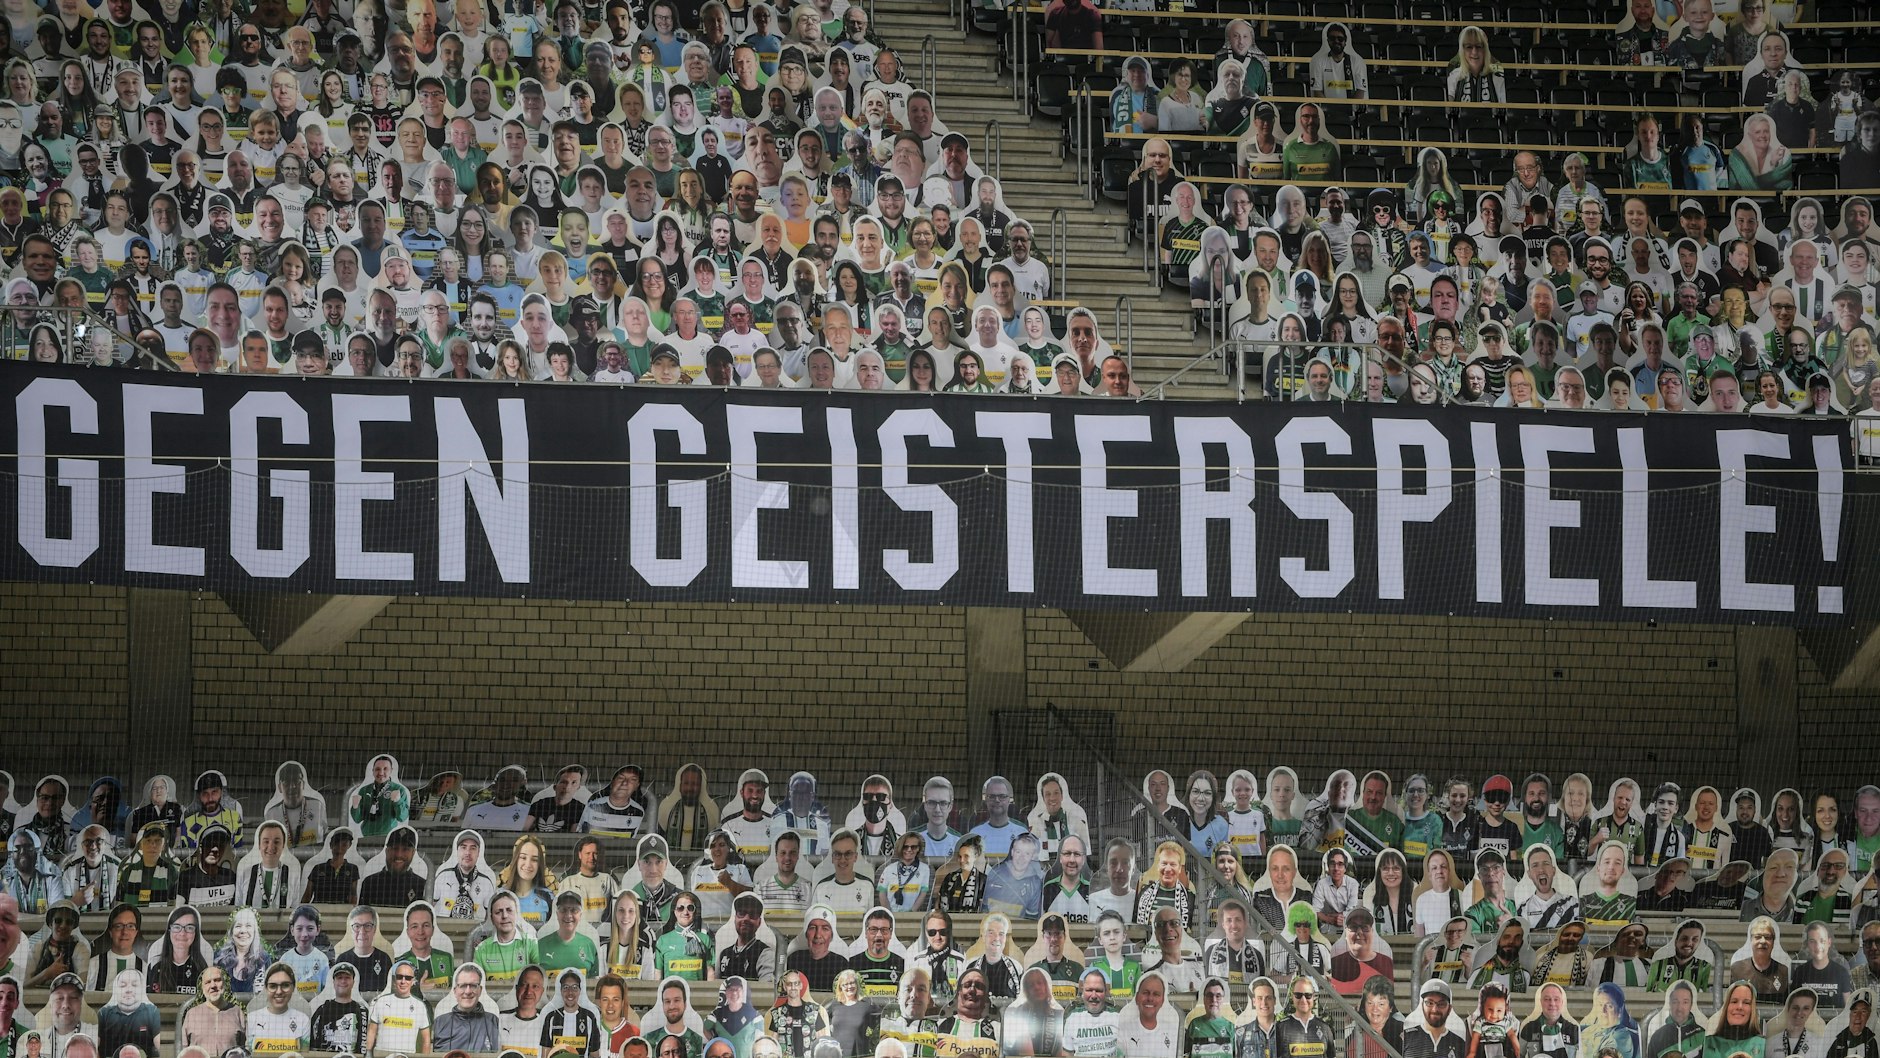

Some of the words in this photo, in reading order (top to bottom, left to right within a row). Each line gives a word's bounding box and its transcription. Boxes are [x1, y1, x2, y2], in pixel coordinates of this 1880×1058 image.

[15, 377, 530, 583] GEGEN
[627, 403, 1844, 613] GEISTERSPIELE!
[870, 986, 895, 995] Postbank
[1076, 1026, 1113, 1038] ANTONIA
